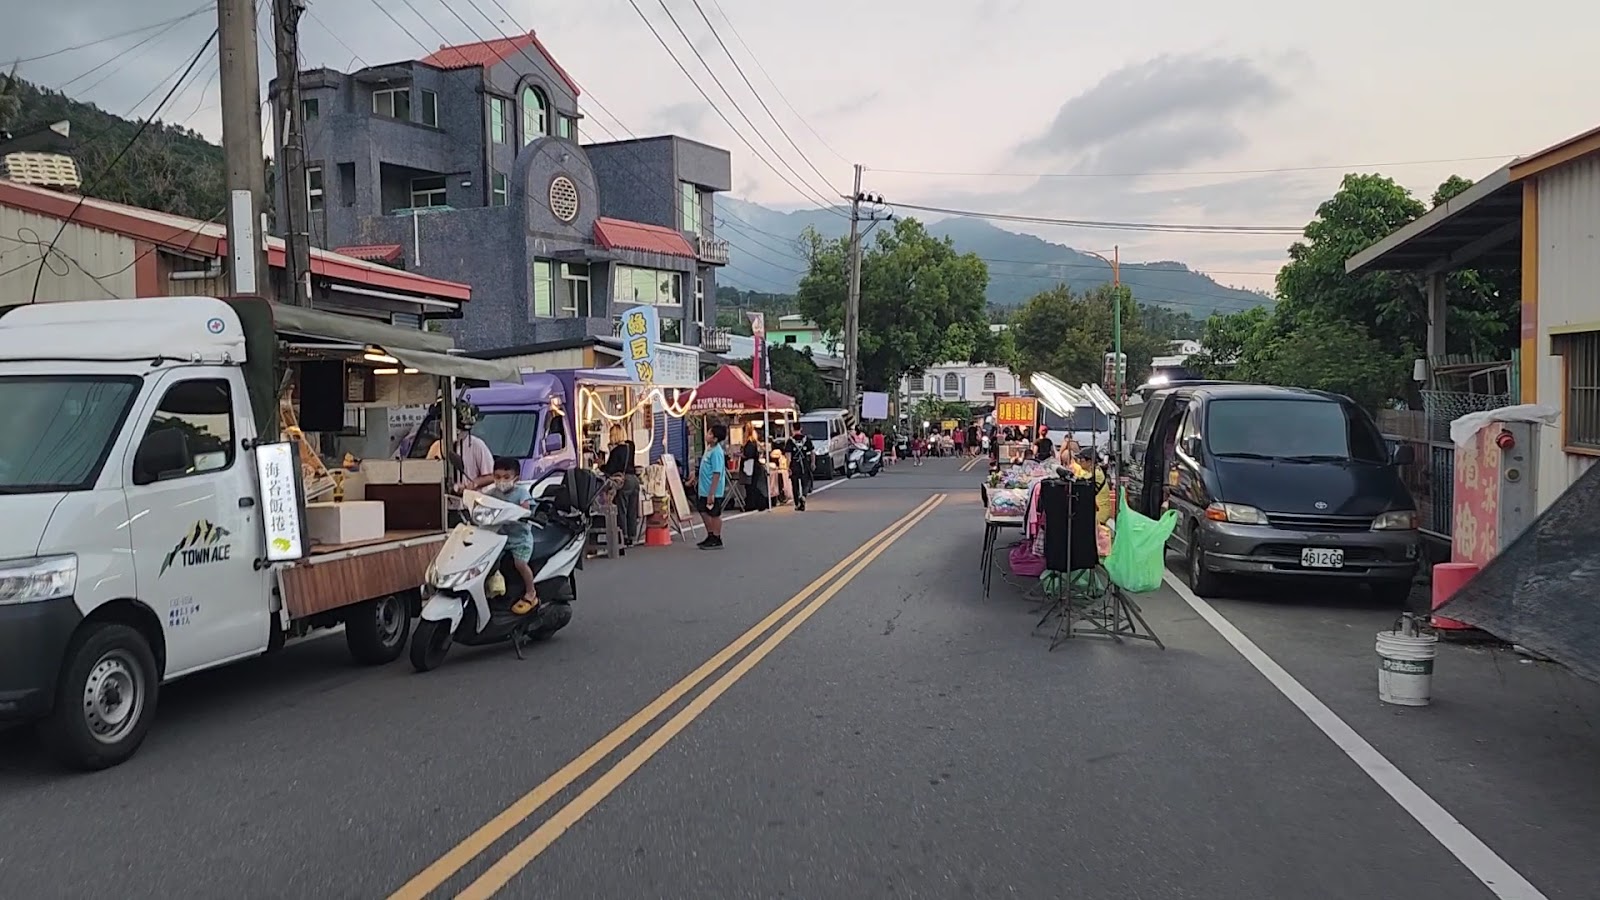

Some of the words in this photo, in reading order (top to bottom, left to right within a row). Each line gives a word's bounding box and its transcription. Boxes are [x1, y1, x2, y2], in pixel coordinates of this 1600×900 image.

[696, 396, 733, 405] TURKISH
[181, 546, 210, 567] TOWN
[211, 544, 231, 562] ACE
